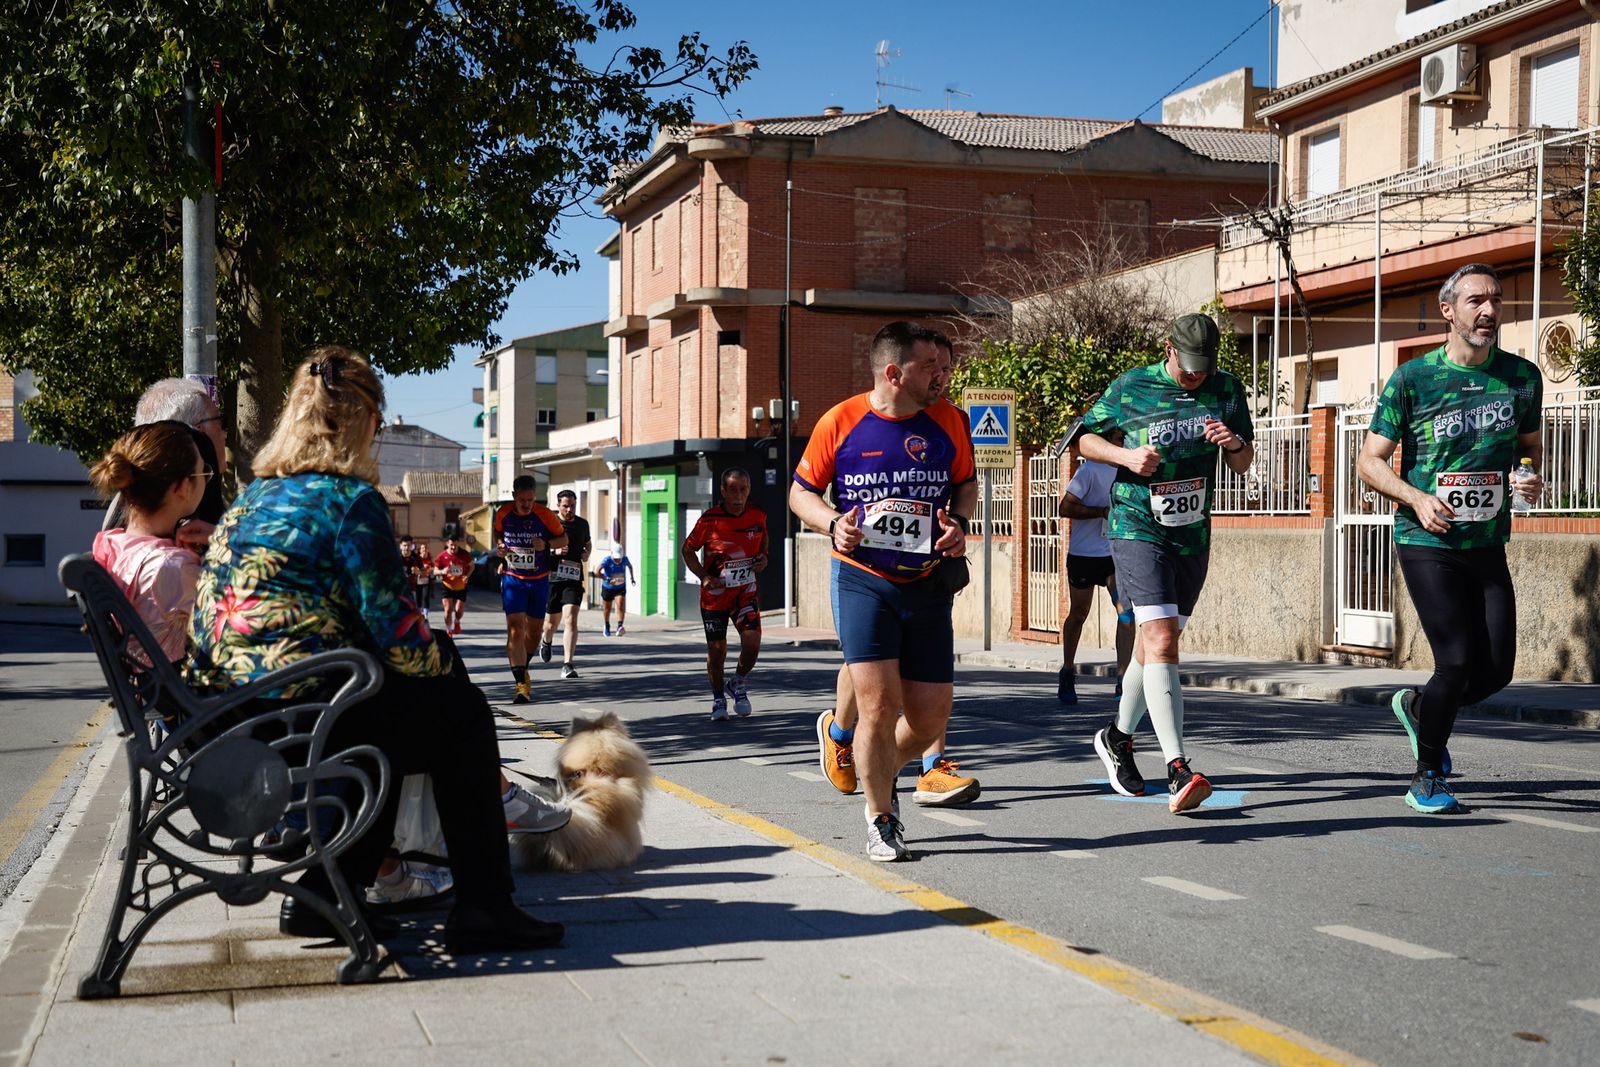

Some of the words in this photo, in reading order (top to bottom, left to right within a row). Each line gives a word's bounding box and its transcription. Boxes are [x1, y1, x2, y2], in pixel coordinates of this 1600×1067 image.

[967, 392, 1013, 401] ATENCIÓN
[1433, 413, 1462, 428] GRAN
[1465, 401, 1501, 418] PREMIO
[1434, 404, 1514, 443] FONDO
[1148, 422, 1174, 435] GRAN
[1177, 414, 1211, 428] PREMIO
[1495, 420, 1516, 431] 2026
[1149, 423, 1206, 446] FOND
[844, 472, 889, 486] DONA
[893, 468, 949, 483] MÉDULA
[1442, 476, 1454, 484] 39
[1454, 477, 1488, 485] FONDO
[1165, 483, 1195, 493] FONDO
[1162, 494, 1199, 515] 280
[1448, 489, 1494, 508] 662
[881, 503, 916, 513] FONDO
[873, 515, 921, 539] 494
[508, 554, 533, 563] 1210
[731, 566, 752, 580] 727
